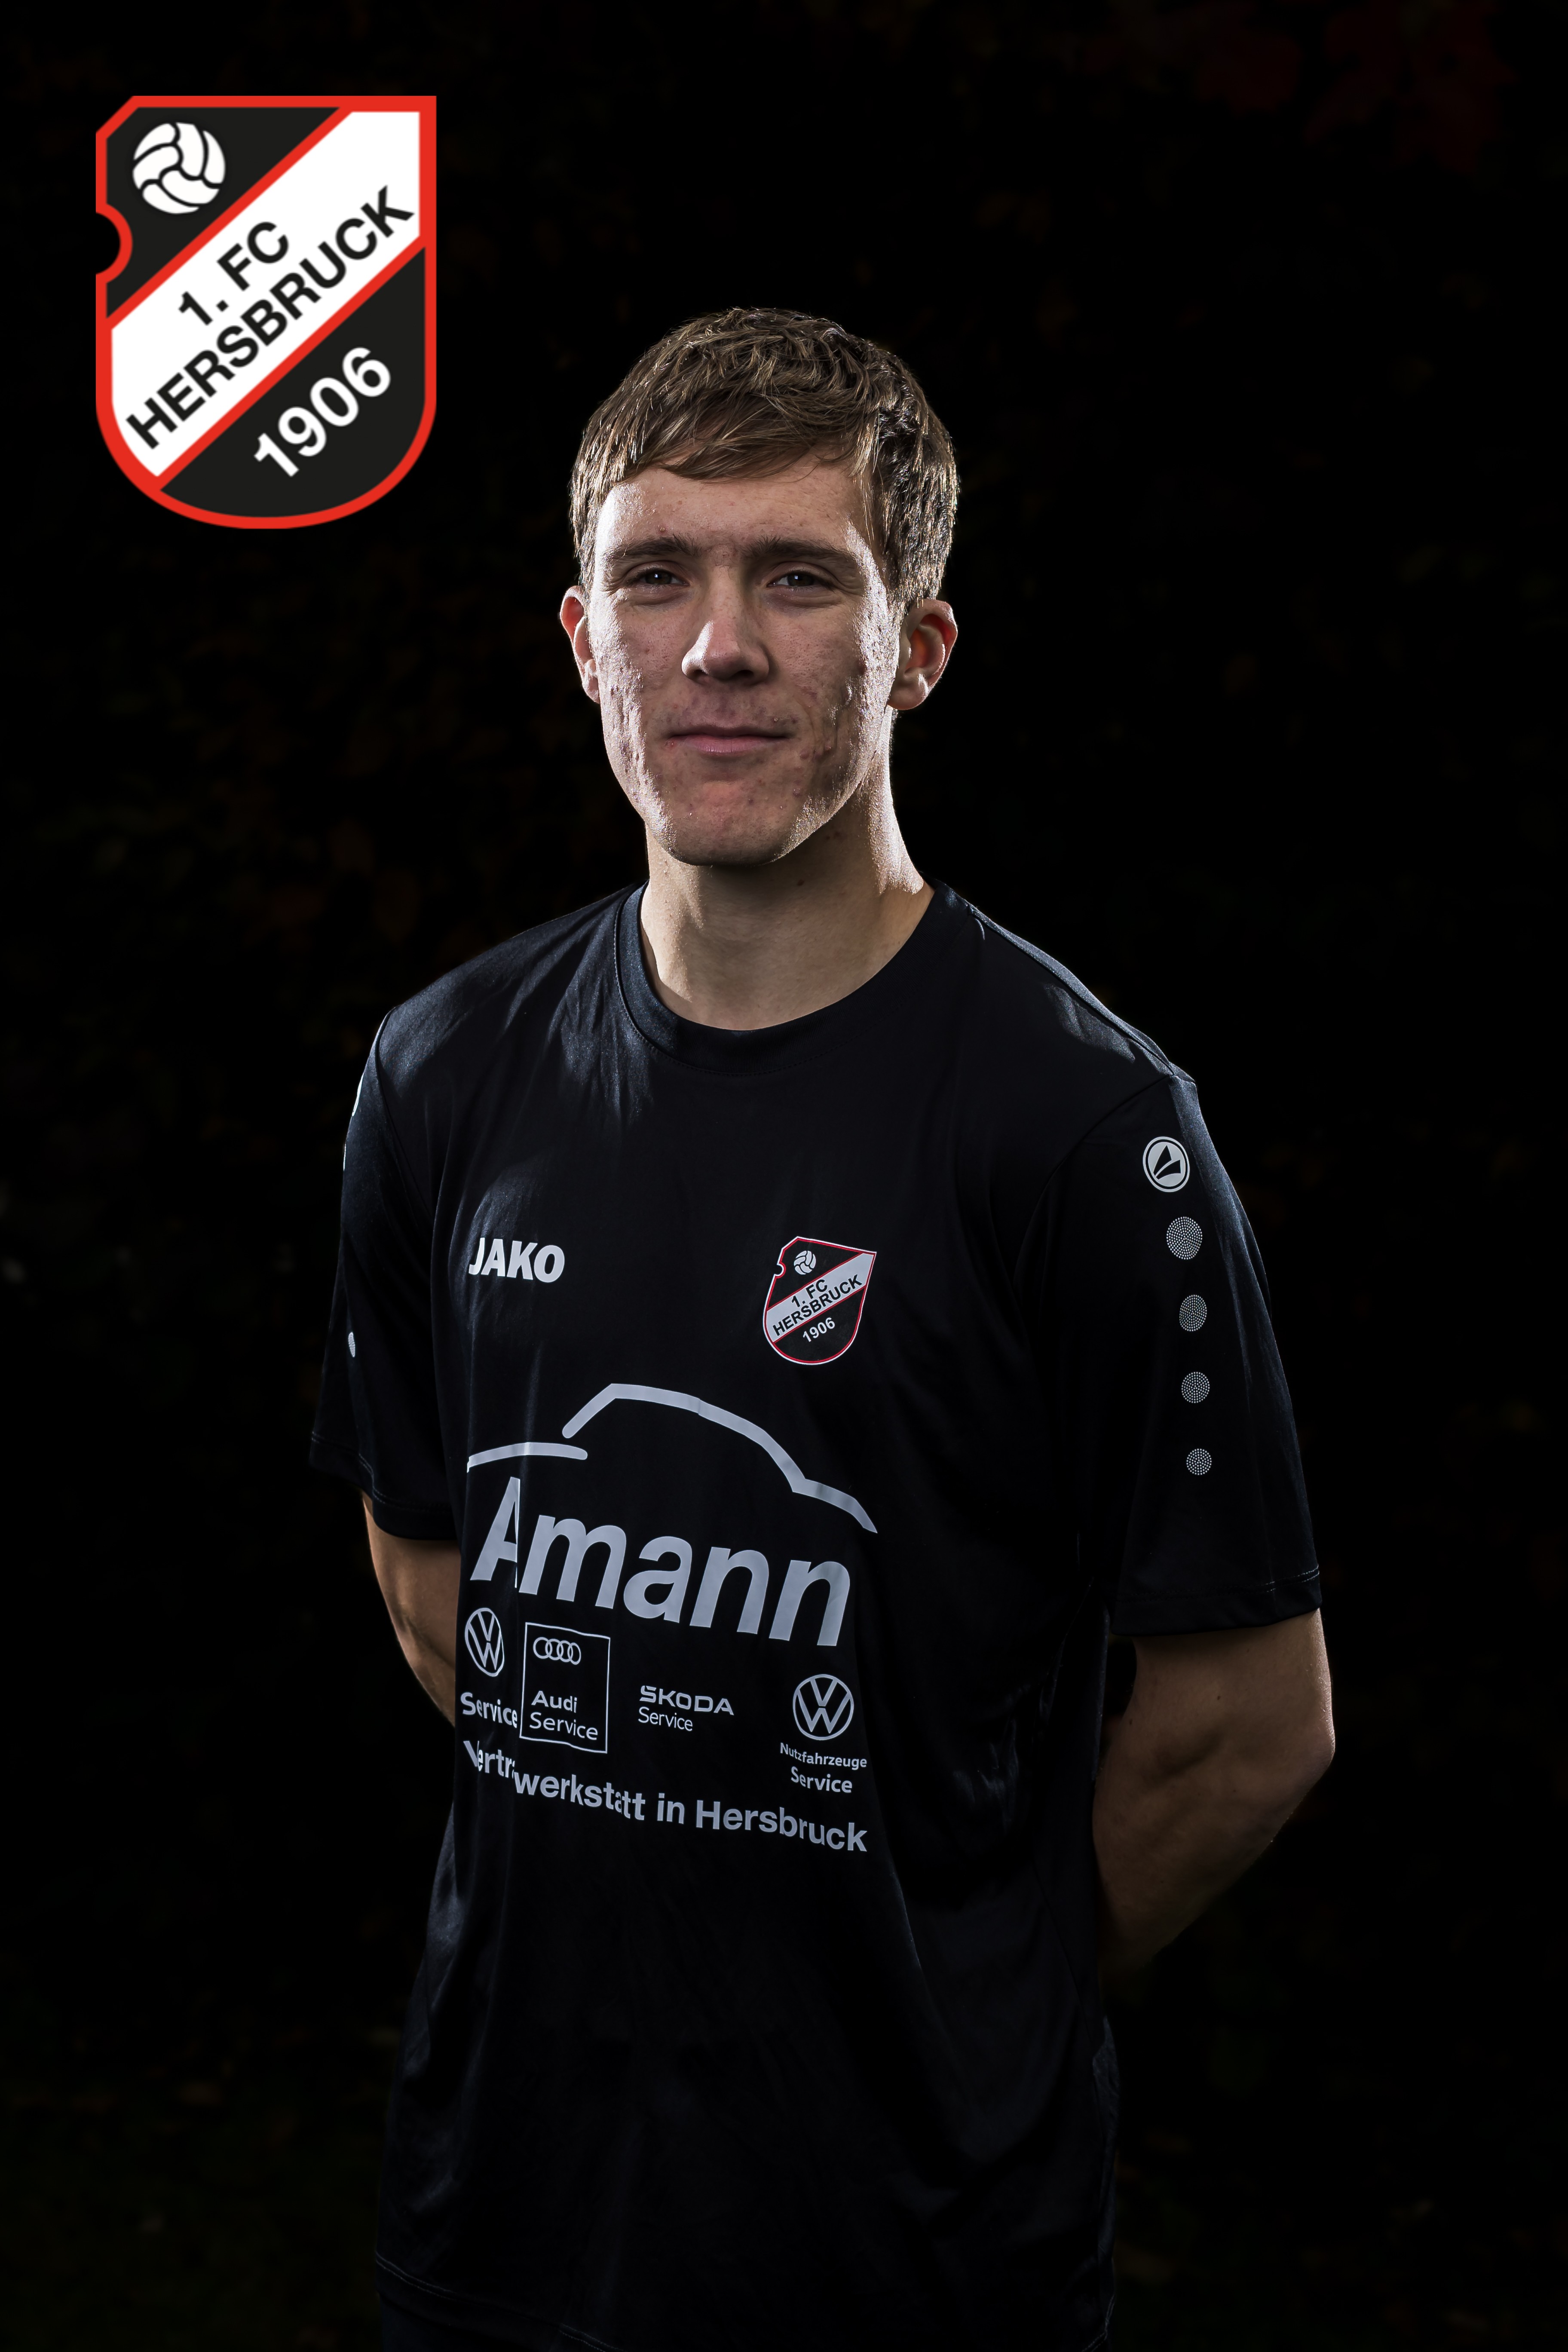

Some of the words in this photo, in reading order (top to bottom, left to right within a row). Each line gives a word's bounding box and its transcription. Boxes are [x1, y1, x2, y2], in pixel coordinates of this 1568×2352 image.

[469, 1237, 565, 1283] JAKO
[772, 1274, 863, 1336] HERSBRUCK
[791, 1295, 805, 1308] 1.
[805, 1279, 827, 1299] FC
[803, 1317, 835, 1342] 1906
[470, 1477, 850, 1646] Amann
[460, 1692, 517, 1728] Service
[531, 1690, 577, 1713] Audi
[530, 1712, 598, 1740] Service
[638, 1706, 693, 1731] Service
[780, 1743, 867, 1770] Nutzfahrzeuge
[791, 1767, 852, 1793] Service
[657, 1793, 685, 1824] in
[696, 1800, 867, 1852] Hersbruck
